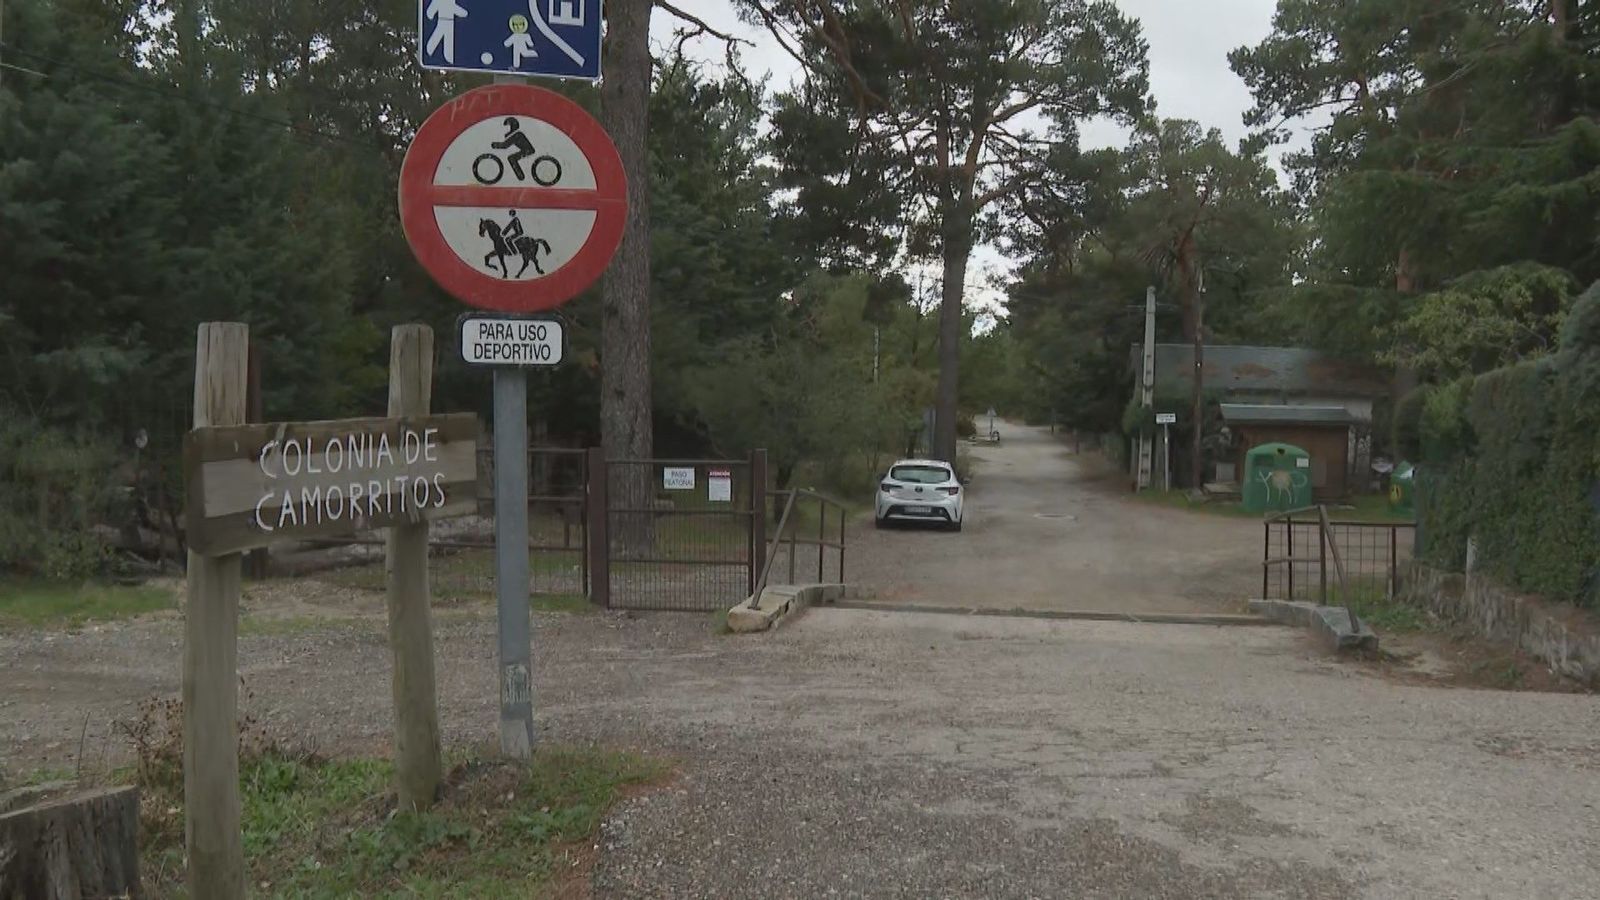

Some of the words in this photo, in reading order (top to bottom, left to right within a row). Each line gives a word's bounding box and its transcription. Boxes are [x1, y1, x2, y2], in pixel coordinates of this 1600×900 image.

[479, 323, 514, 341] PARA
[518, 324, 547, 341] USO
[474, 343, 551, 361] DEPORTIVO
[260, 432, 394, 479] COLONIA
[405, 428, 439, 465] DE
[671, 470, 688, 478] PASO
[255, 472, 446, 532] CAMORRITOS
